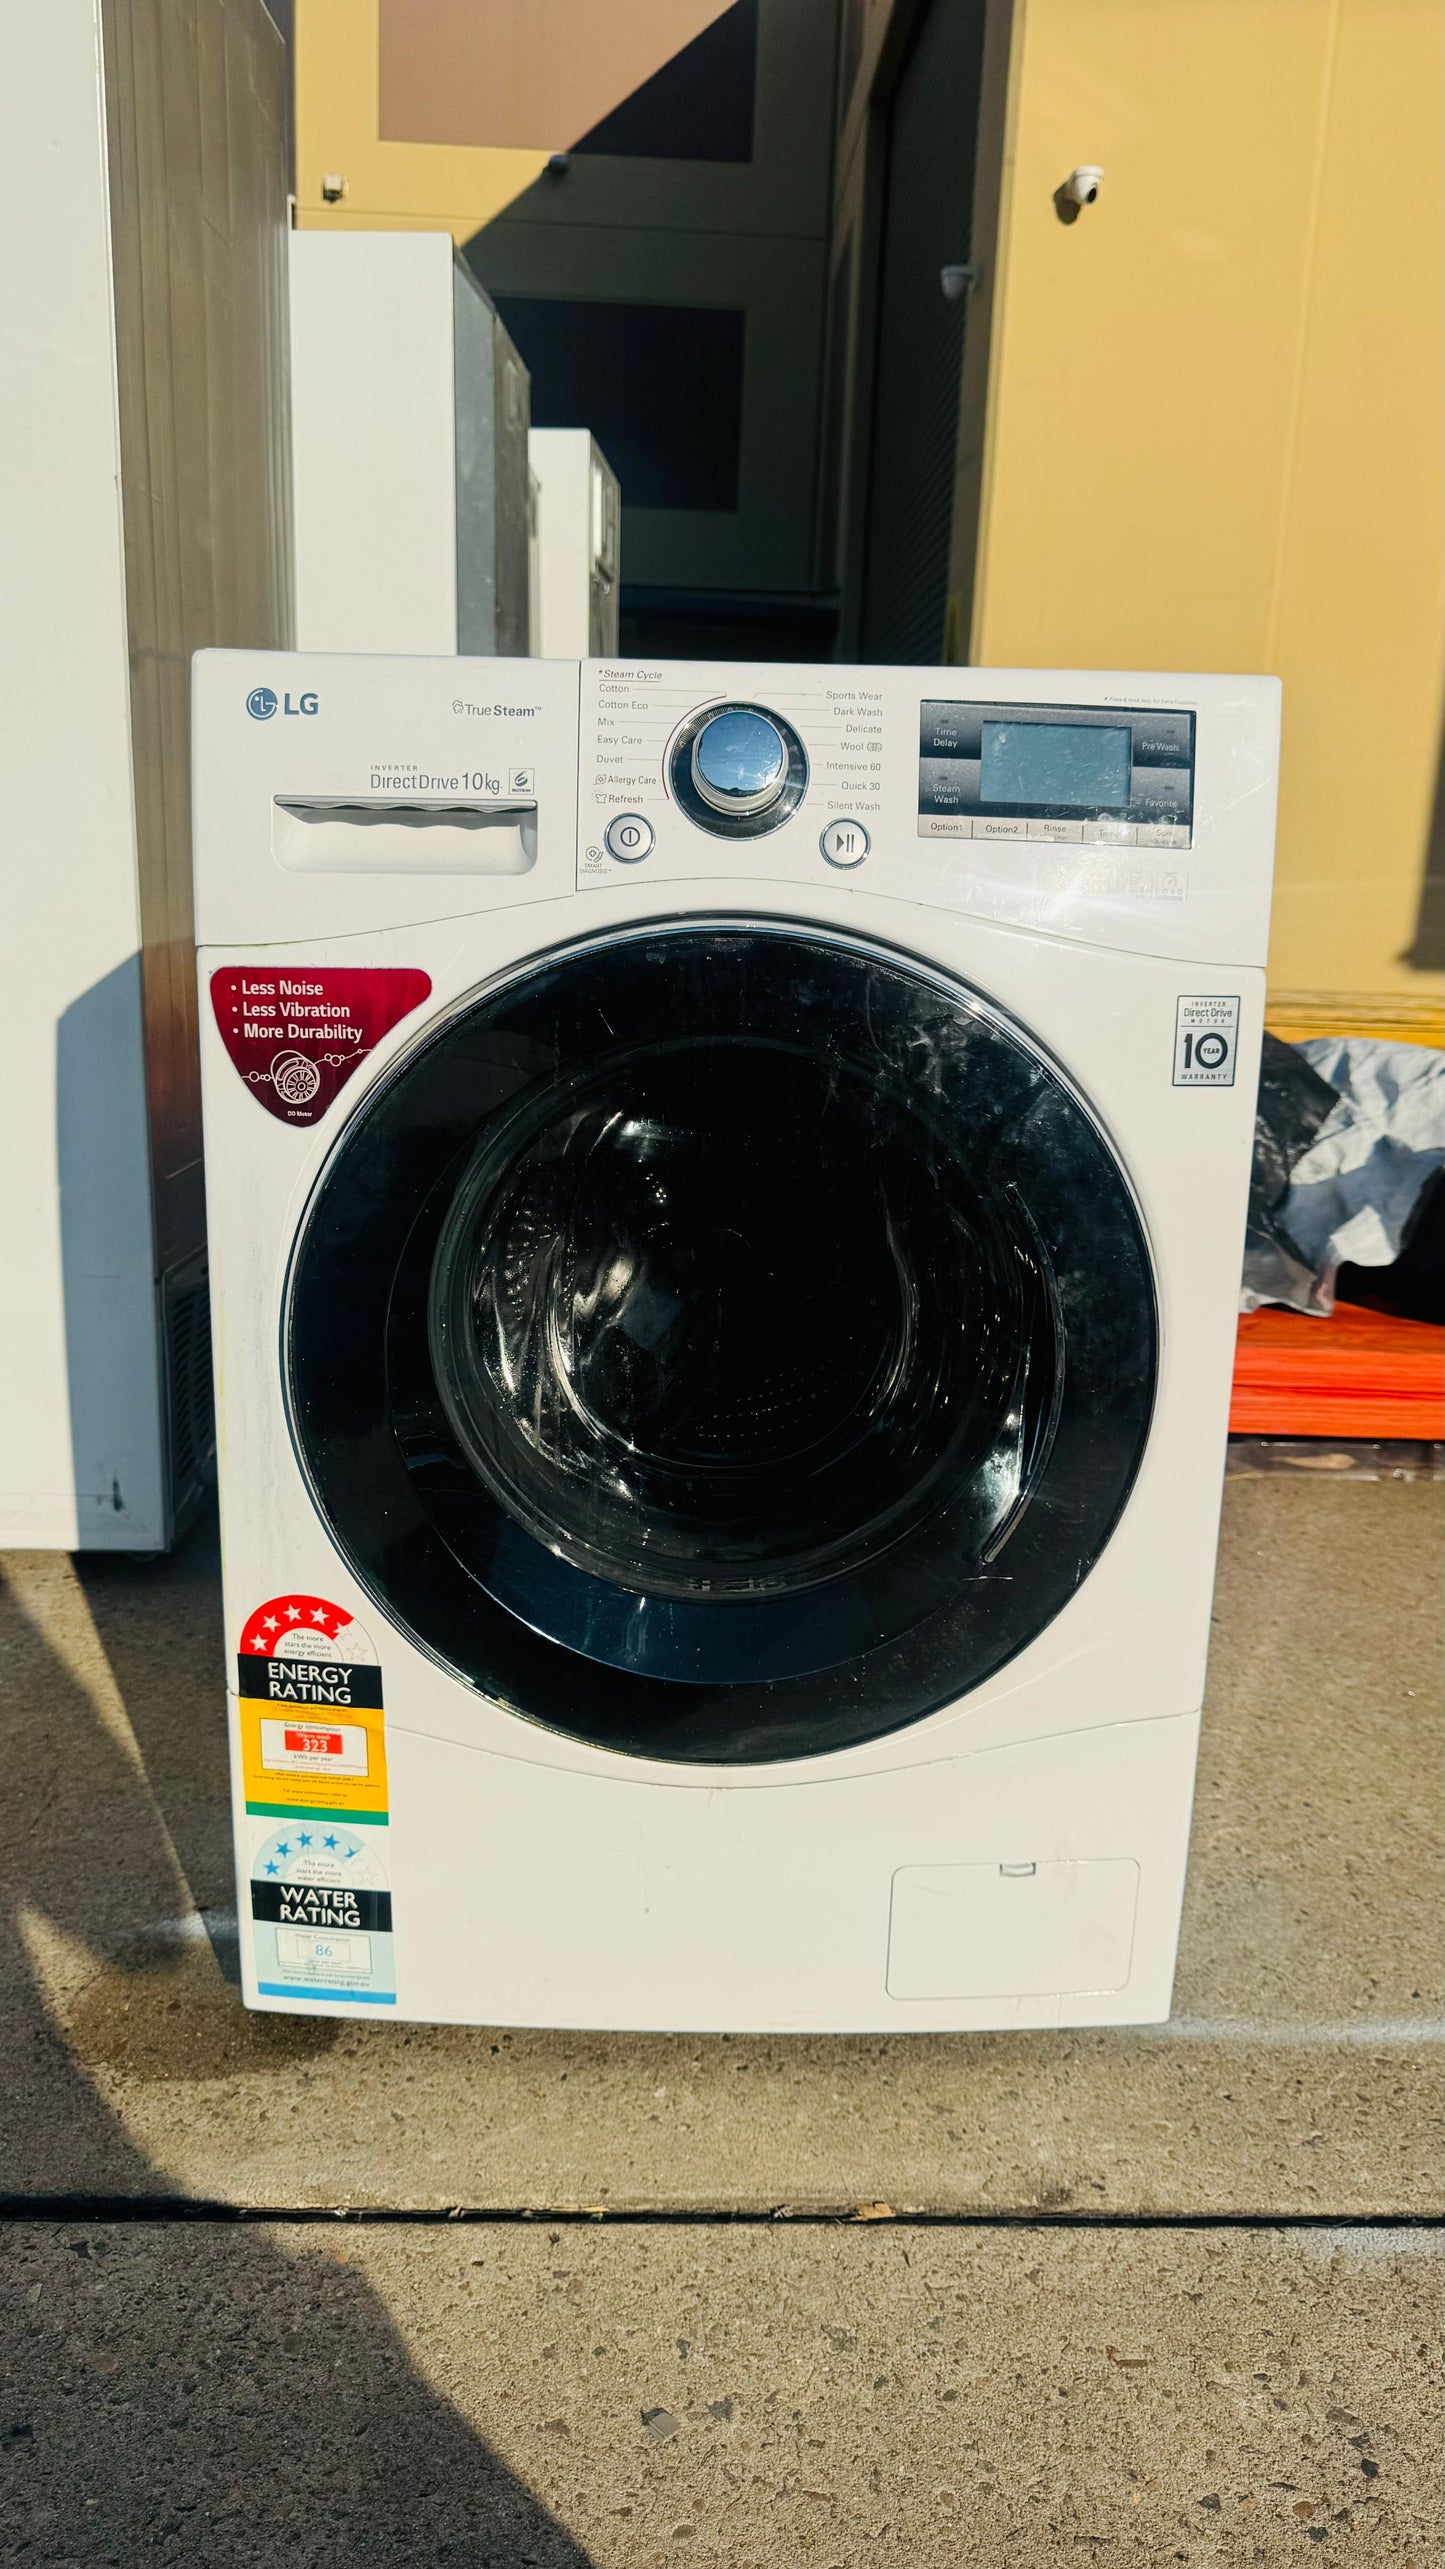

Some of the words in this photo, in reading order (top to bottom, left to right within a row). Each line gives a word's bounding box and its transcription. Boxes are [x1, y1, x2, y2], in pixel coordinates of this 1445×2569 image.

[604, 669, 634, 679] Steam
[637, 670, 662, 680] Cycle
[599, 683, 630, 693] Cotton
[826, 690, 856, 701] Sports
[858, 691, 883, 701] Wear
[284, 692, 319, 715] LG
[598, 699, 629, 709] Cotton
[631, 701, 648, 710] Eco
[833, 707, 855, 716] Dark
[857, 707, 883, 717] Wash
[597, 717, 615, 726] Mix
[845, 724, 882, 734] Delicate
[935, 727, 957, 736] Time
[597, 734, 619, 745] Easy
[621, 735, 643, 745] Care
[933, 738, 958, 748] Delay
[840, 742, 864, 751] Wool
[1156, 742, 1180, 752] Wash
[596, 754, 623, 764] Duvet
[826, 761, 868, 771] Intensive
[870, 762, 881, 771] 60
[607, 775, 636, 786] Allergy
[638, 776, 657, 785] Care
[841, 780, 867, 790] Quick
[869, 782, 881, 791] 30
[932, 783, 961, 793] Steam
[608, 794, 643, 804] Refresh
[934, 795, 959, 804] Wash
[1145, 798, 1178, 808] Favorite
[827, 800, 853, 810] Silent
[855, 801, 880, 811] Wash
[985, 824, 1019, 834] Option2
[1043, 823, 1067, 832] Rinse
[241, 979, 276, 995] Less
[279, 980, 324, 996] Noise
[242, 1001, 277, 1017] Less
[279, 1001, 351, 1018] Vibration
[243, 1023, 284, 1038] More
[287, 1024, 363, 1044] Durability
[1184, 1033, 1228, 1069] 10
[1203, 1047, 1221, 1055] YEAR
[1181, 1073, 1228, 1081] WARRANTY
[283, 1648, 306, 1657] energy
[306, 1650, 333, 1658] efficient
[267, 1662, 352, 1685] ENERGY
[269, 1681, 352, 1705] RATING
[284, 1722, 304, 1730] Energy
[302, 1738, 328, 1753] 323
[280, 1885, 358, 1909] WATER
[280, 1903, 361, 1928] RATING
[315, 1944, 333, 1957] 86
